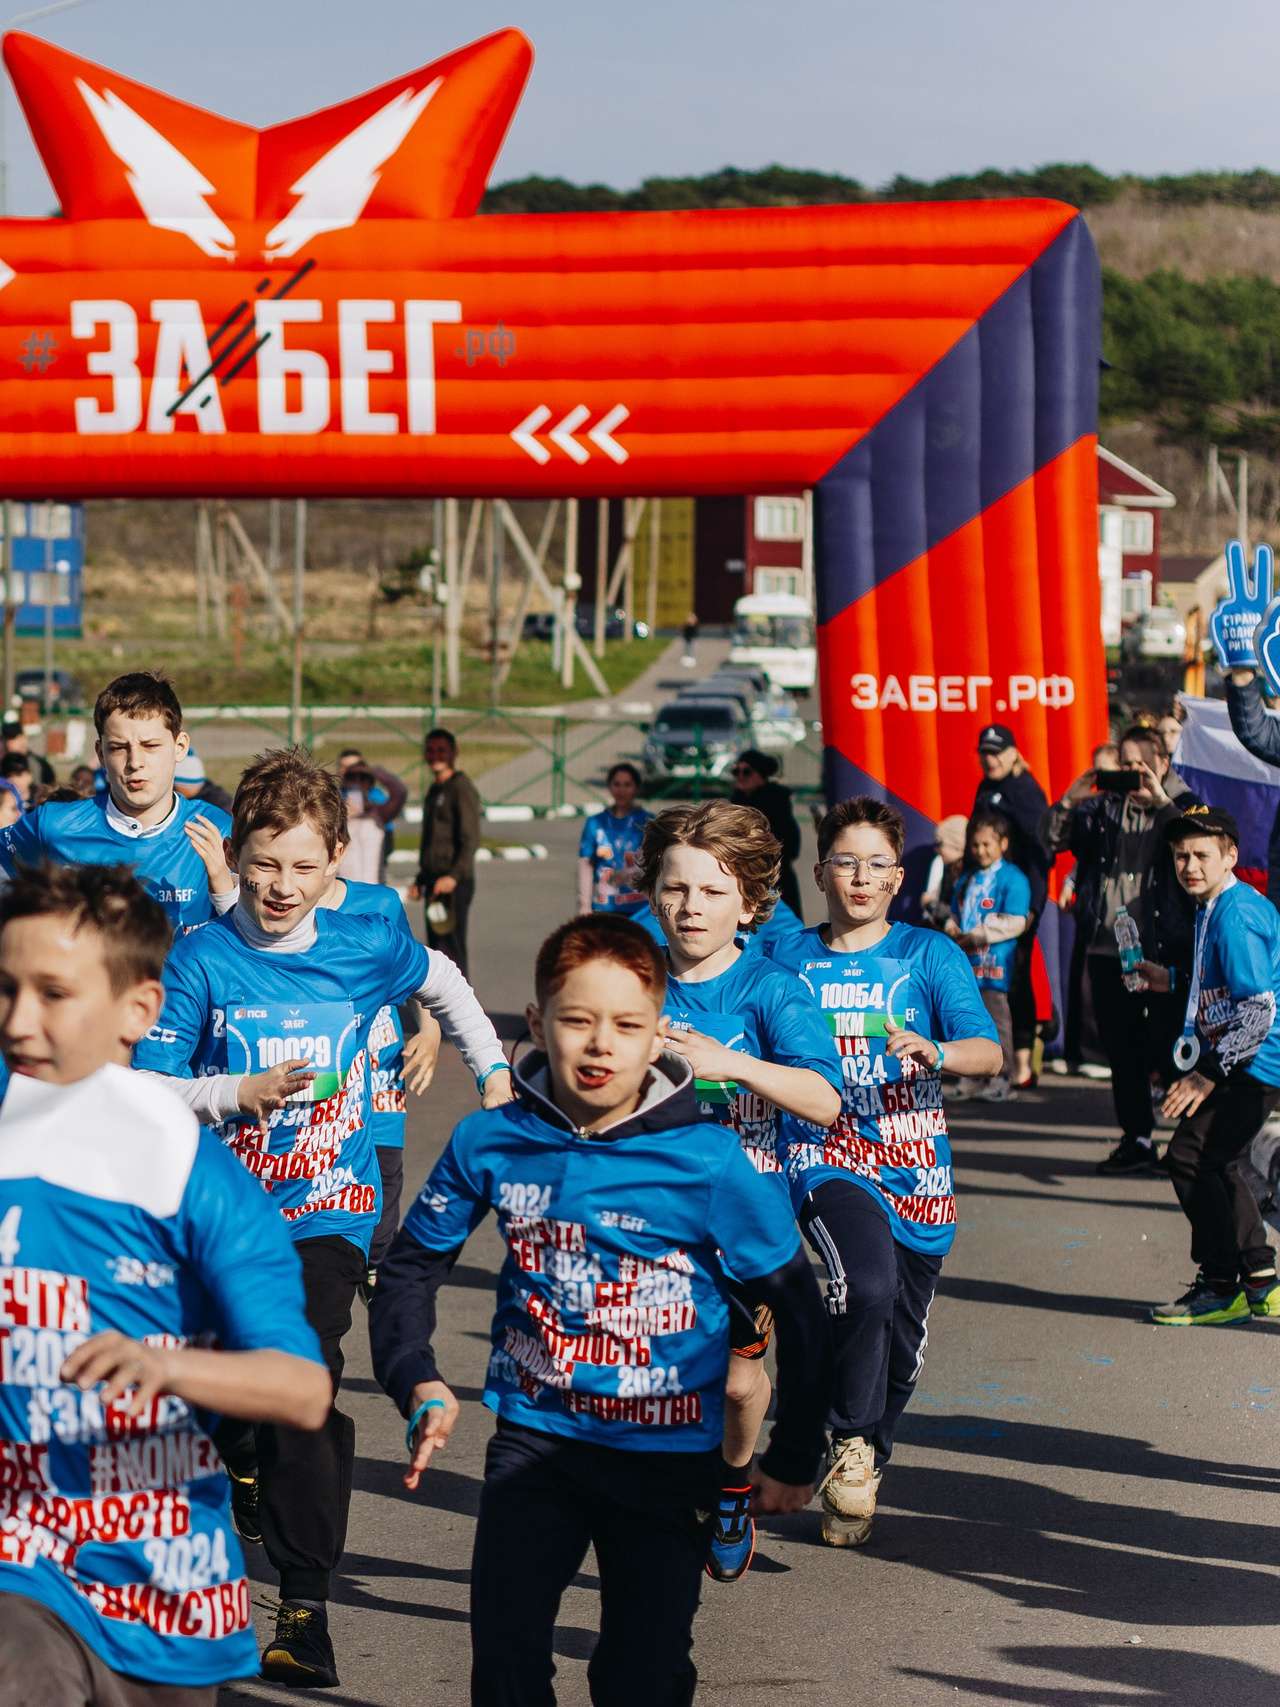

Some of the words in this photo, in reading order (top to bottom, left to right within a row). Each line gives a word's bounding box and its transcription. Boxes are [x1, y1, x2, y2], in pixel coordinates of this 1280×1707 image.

[850, 673, 1075, 712] ЗАБЕГ.РФ
[820, 982, 885, 1010] 10054
[247, 1009, 267, 1019] ПСБ
[256, 1035, 331, 1068] 10029
[617, 1365, 683, 1398] 2024
